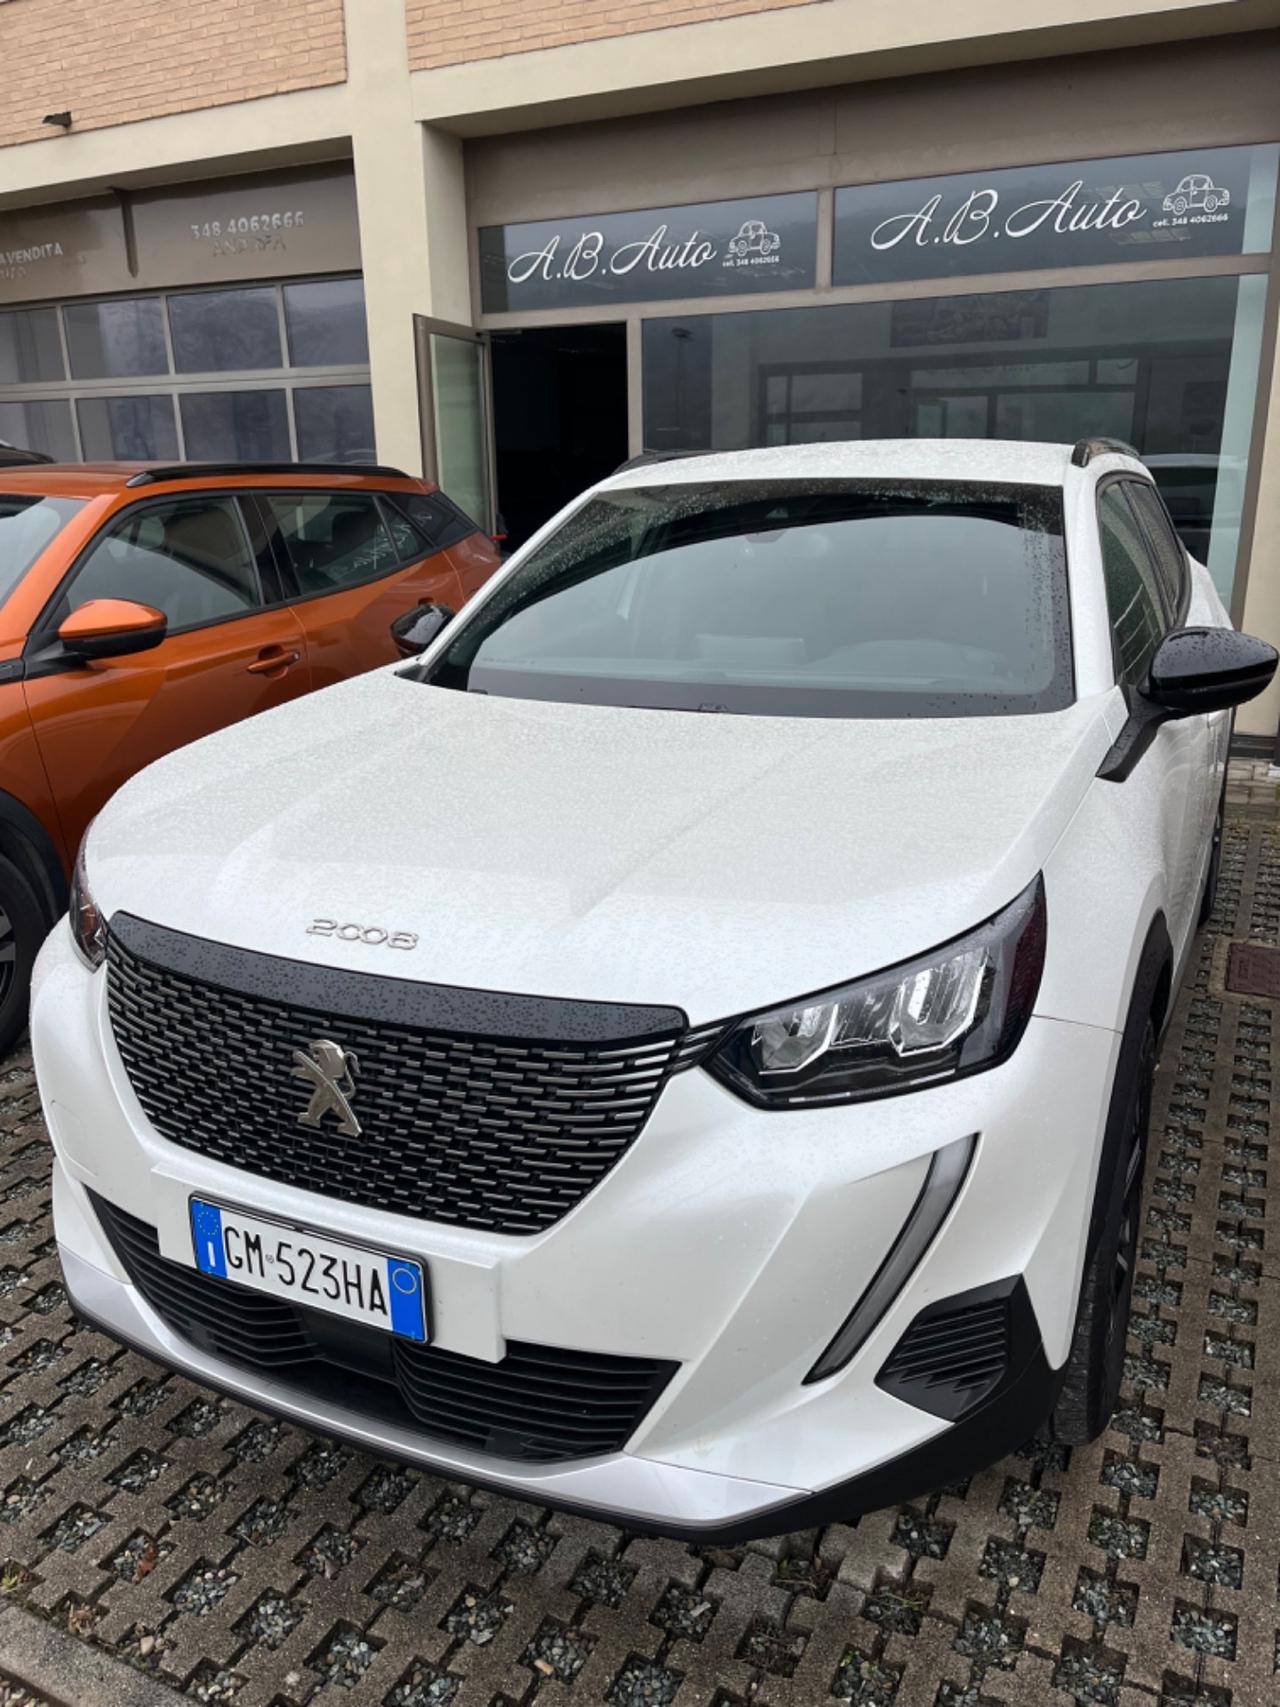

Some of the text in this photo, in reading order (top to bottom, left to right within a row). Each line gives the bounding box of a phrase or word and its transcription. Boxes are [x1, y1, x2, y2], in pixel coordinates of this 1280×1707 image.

[190, 221, 222, 240] 348
[1171, 216, 1188, 226] 348
[305, 918, 420, 951] 2008
[274, 1241, 390, 1317] 523HA
